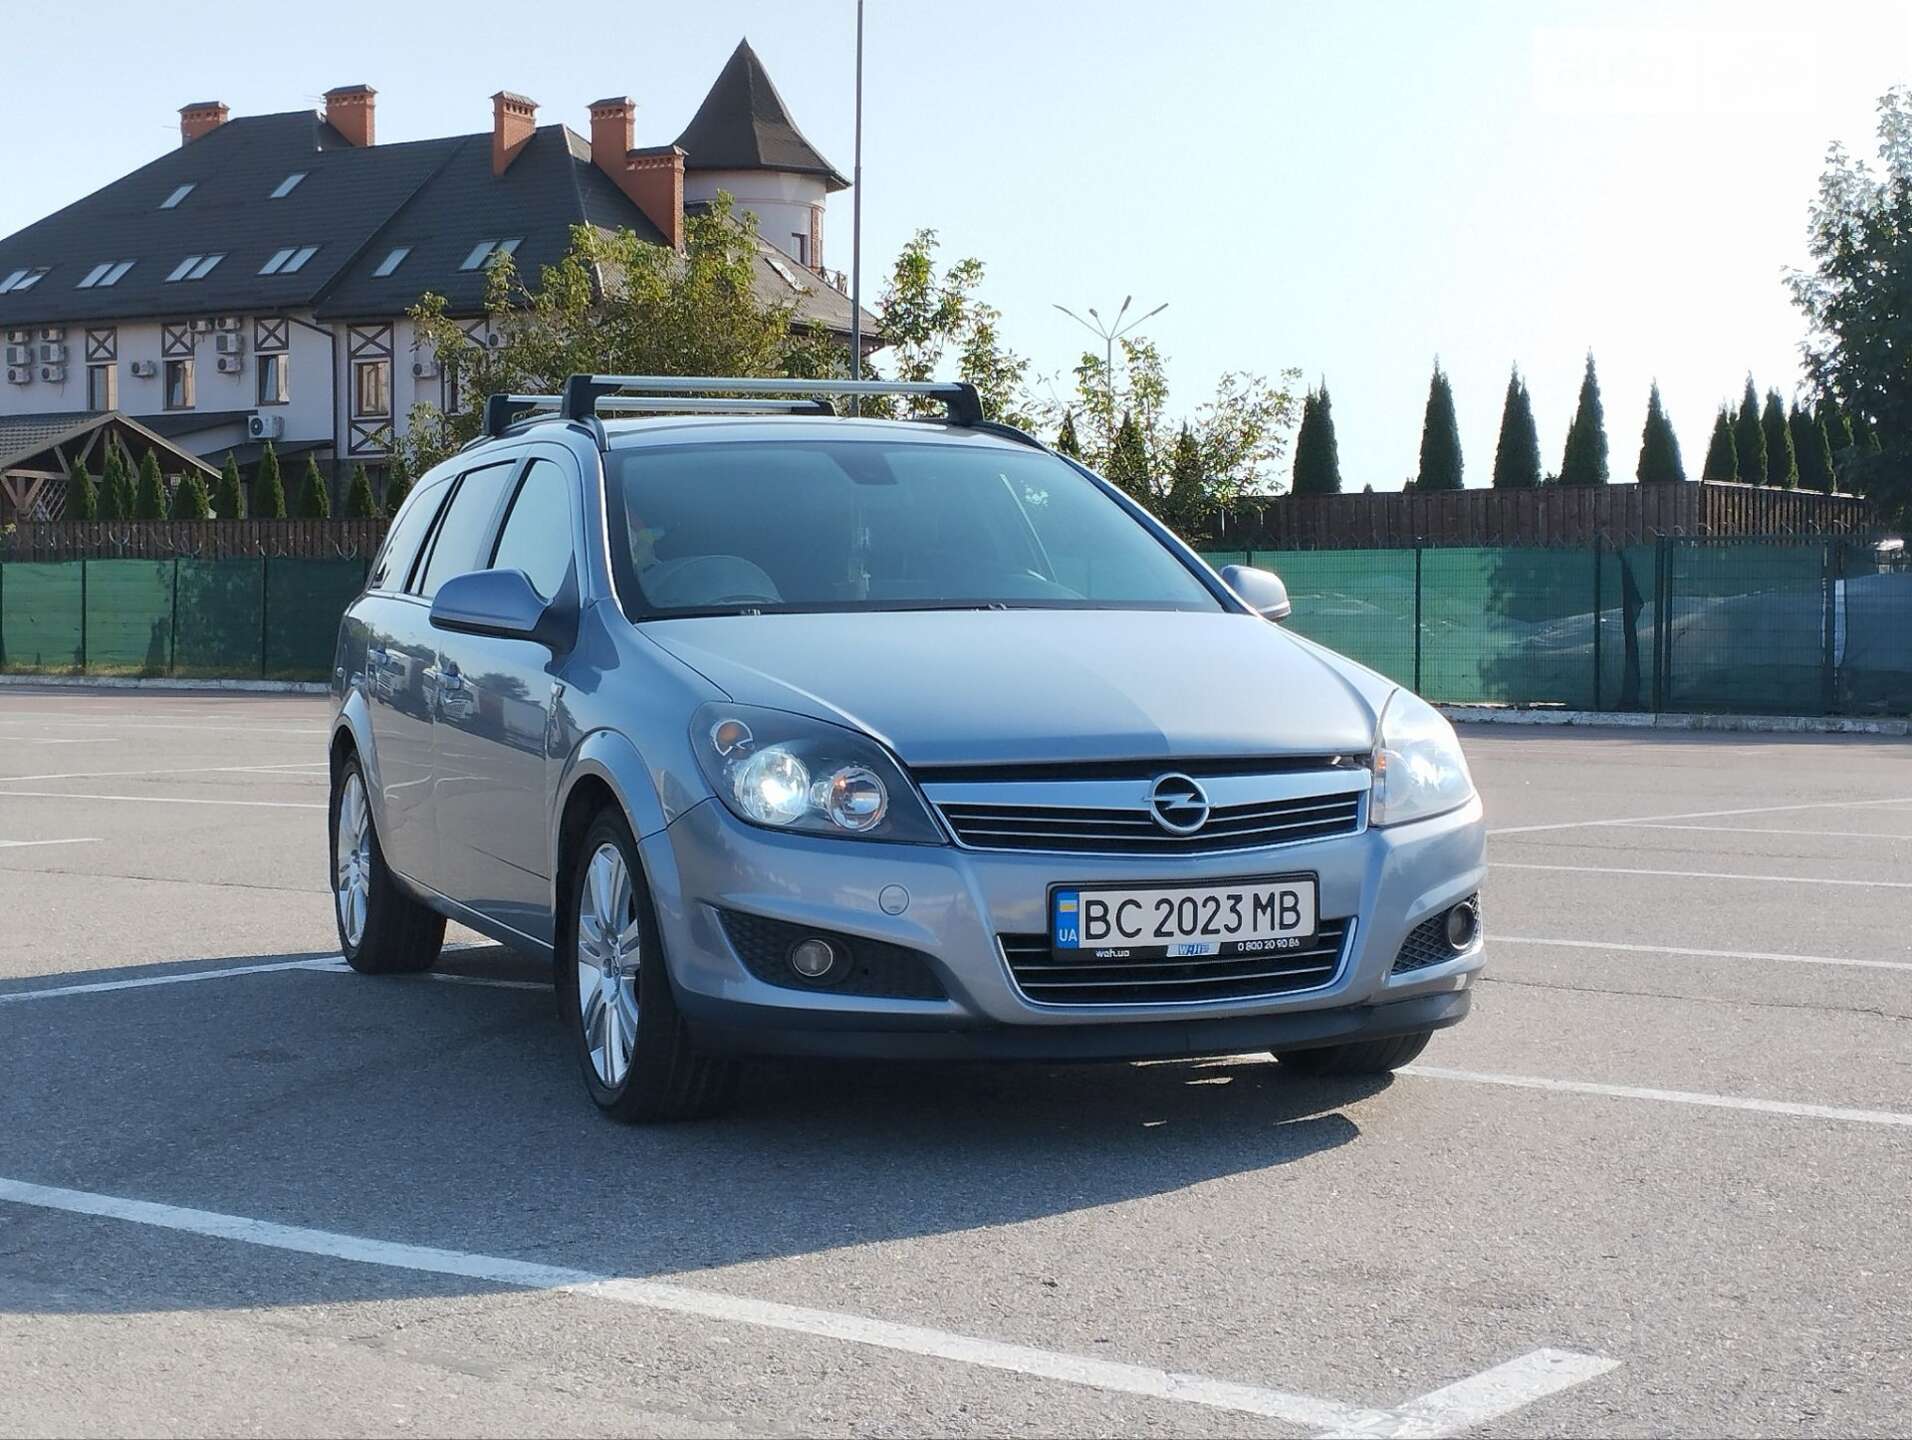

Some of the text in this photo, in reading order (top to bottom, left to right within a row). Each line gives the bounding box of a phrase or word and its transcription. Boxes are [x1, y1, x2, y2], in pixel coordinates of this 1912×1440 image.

[1085, 890, 1301, 941] BC 2023 MB
[1059, 928, 1078, 942] UA
[1237, 942, 1245, 952] 0
[1245, 941, 1263, 951] 800
[1264, 939, 1276, 950] 20
[1276, 938, 1288, 948] 90
[1095, 949, 1131, 958] wah.ua
